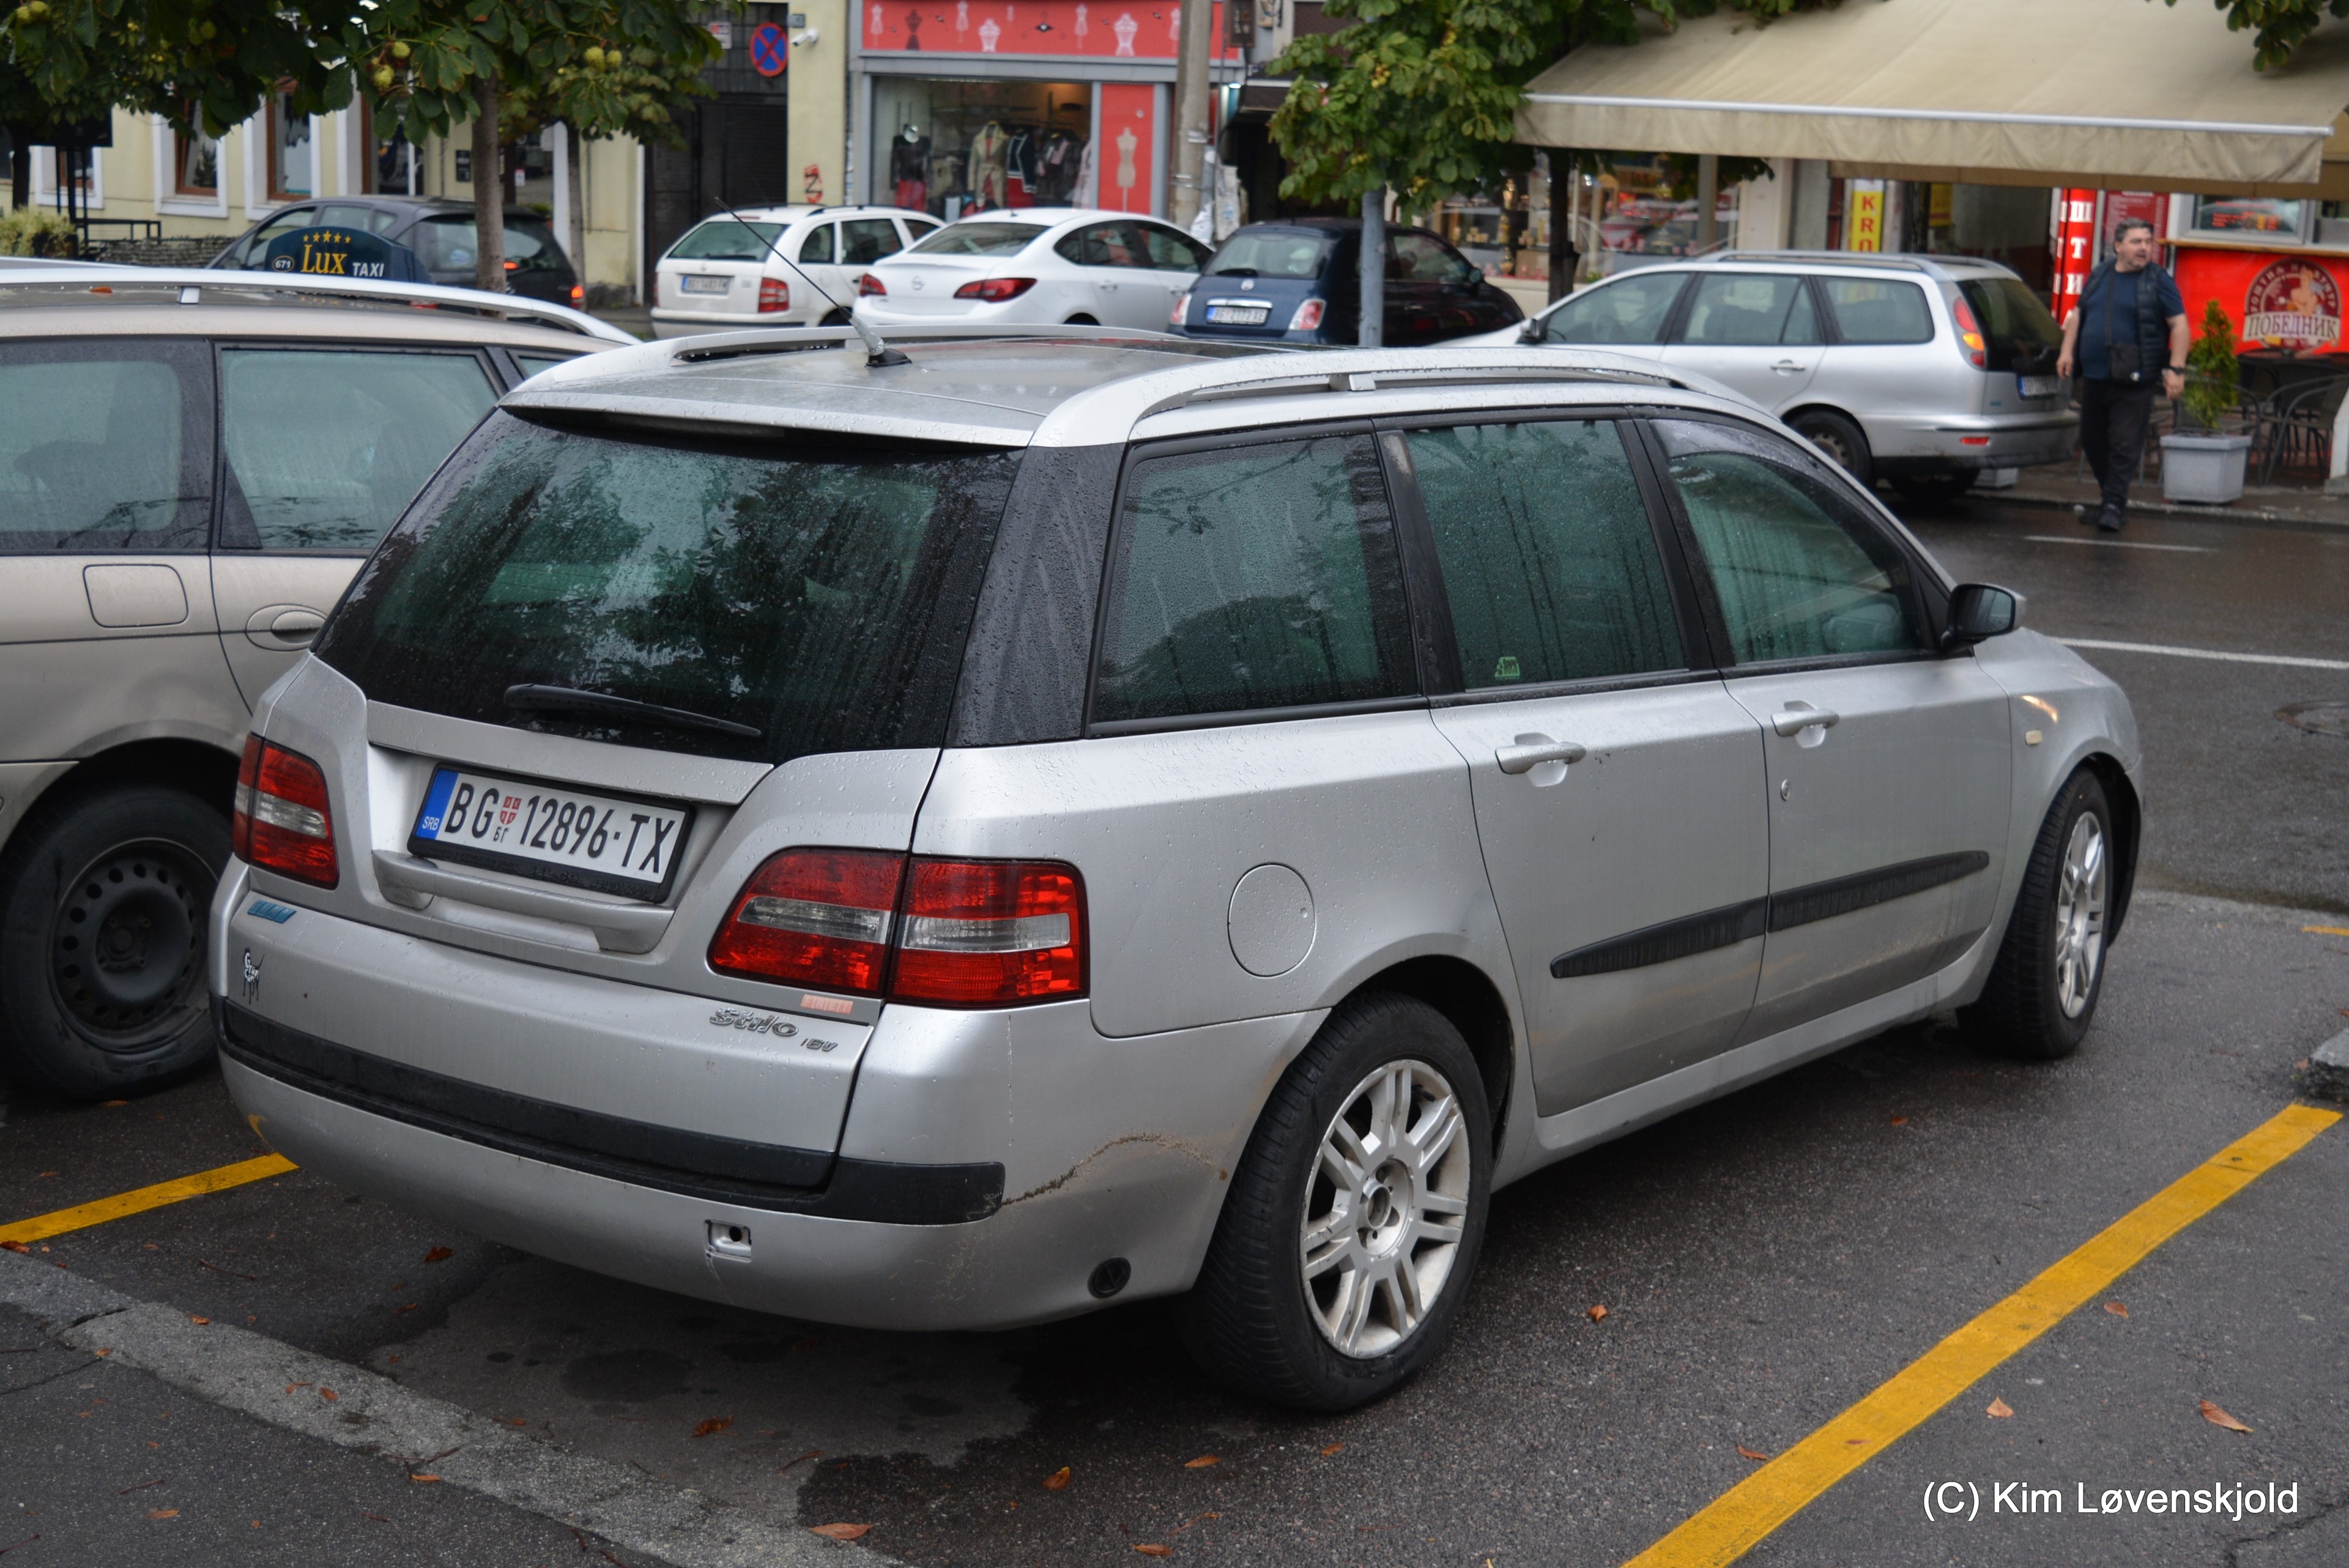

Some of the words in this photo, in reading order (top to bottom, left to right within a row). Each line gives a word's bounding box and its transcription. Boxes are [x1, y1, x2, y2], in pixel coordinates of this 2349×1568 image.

[275, 259, 291, 269] 671
[301, 244, 347, 274] Lux
[352, 262, 385, 277] TAXI
[2249, 314, 2336, 339] ПОБЕДНИК
[421, 816, 440, 831] SRB
[444, 782, 498, 839] BG
[710, 1007, 799, 1036] Stilo
